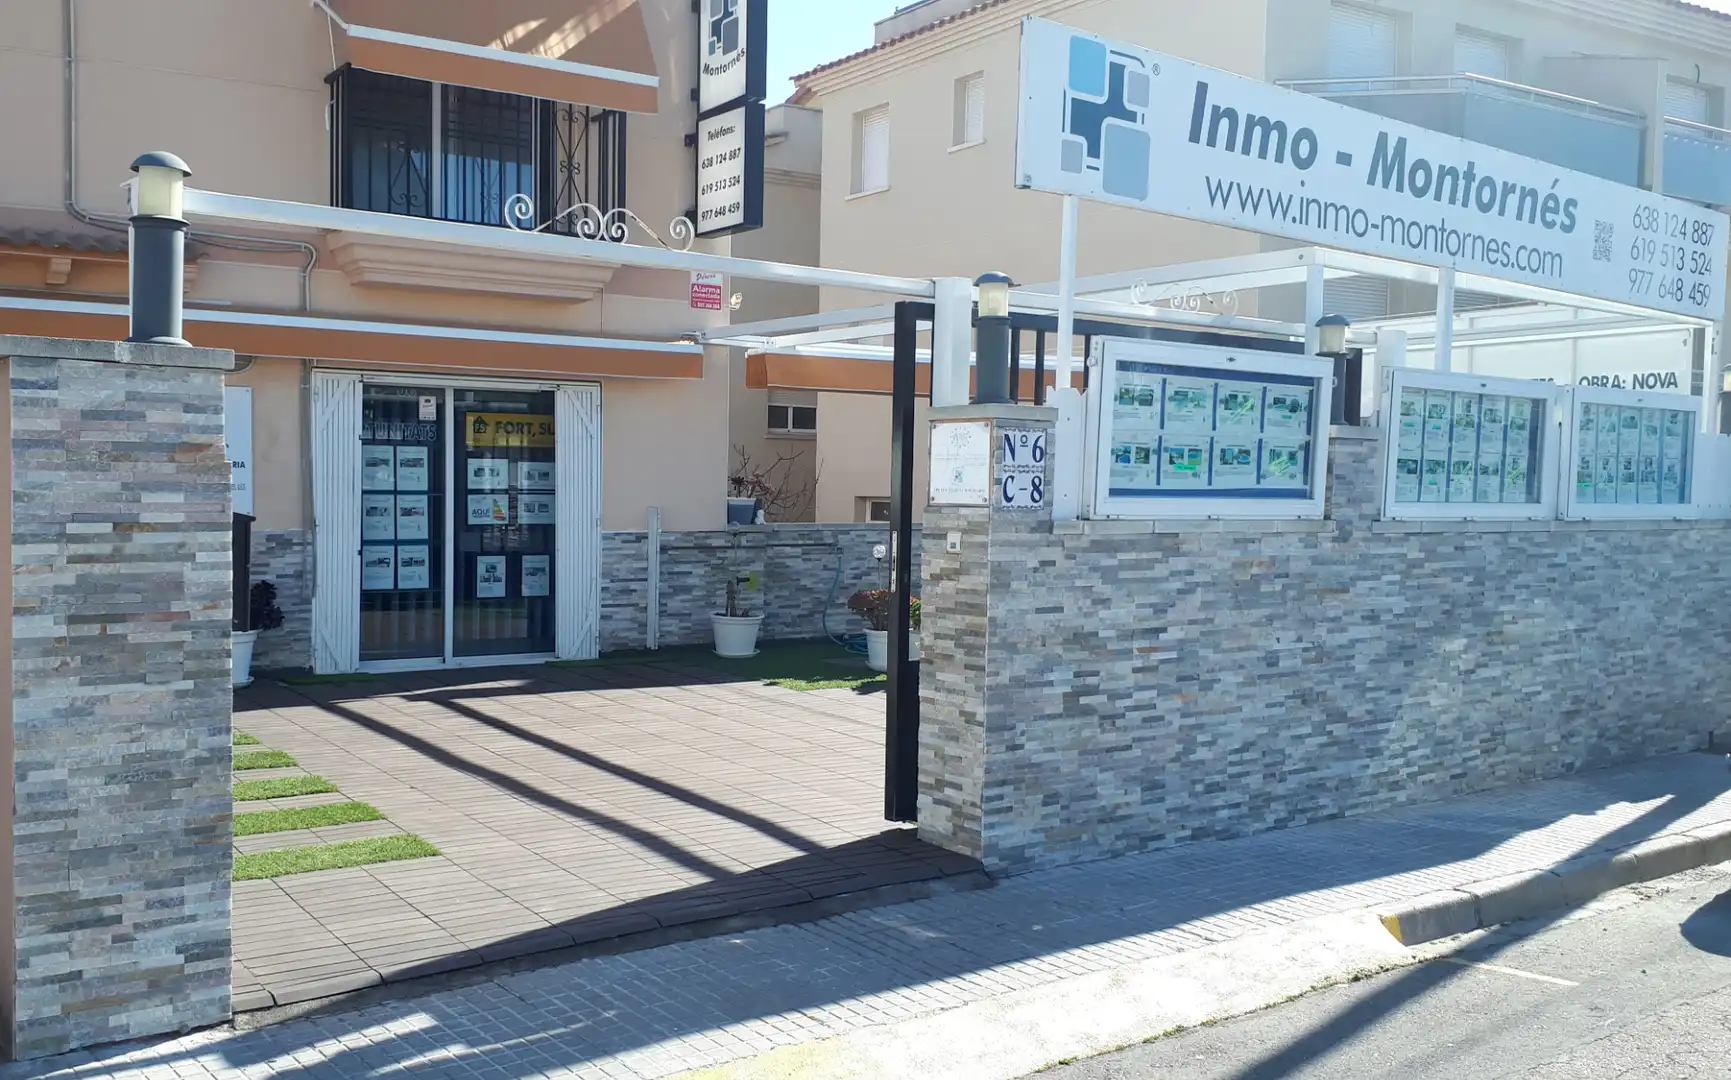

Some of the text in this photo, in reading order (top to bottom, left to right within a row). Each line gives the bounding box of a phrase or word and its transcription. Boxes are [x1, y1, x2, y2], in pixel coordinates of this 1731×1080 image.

[701, 147, 741, 169] 638 124 887
[1188, 80, 1318, 170] Inmo
[1366, 130, 1578, 234] Montornés
[701, 174, 741, 196] 619 513 524
[701, 201, 741, 222] 977 648 459
[1204, 175, 1564, 278] www.inmo-montornes.com
[1632, 204, 1715, 247] 638 124 887
[1630, 235, 1712, 277] 619 513 524
[692, 285, 721, 294] Alarma
[1628, 268, 1711, 308] 977 648 459
[1631, 372, 1678, 390] NOVA
[495, 421, 536, 438] FORT,
